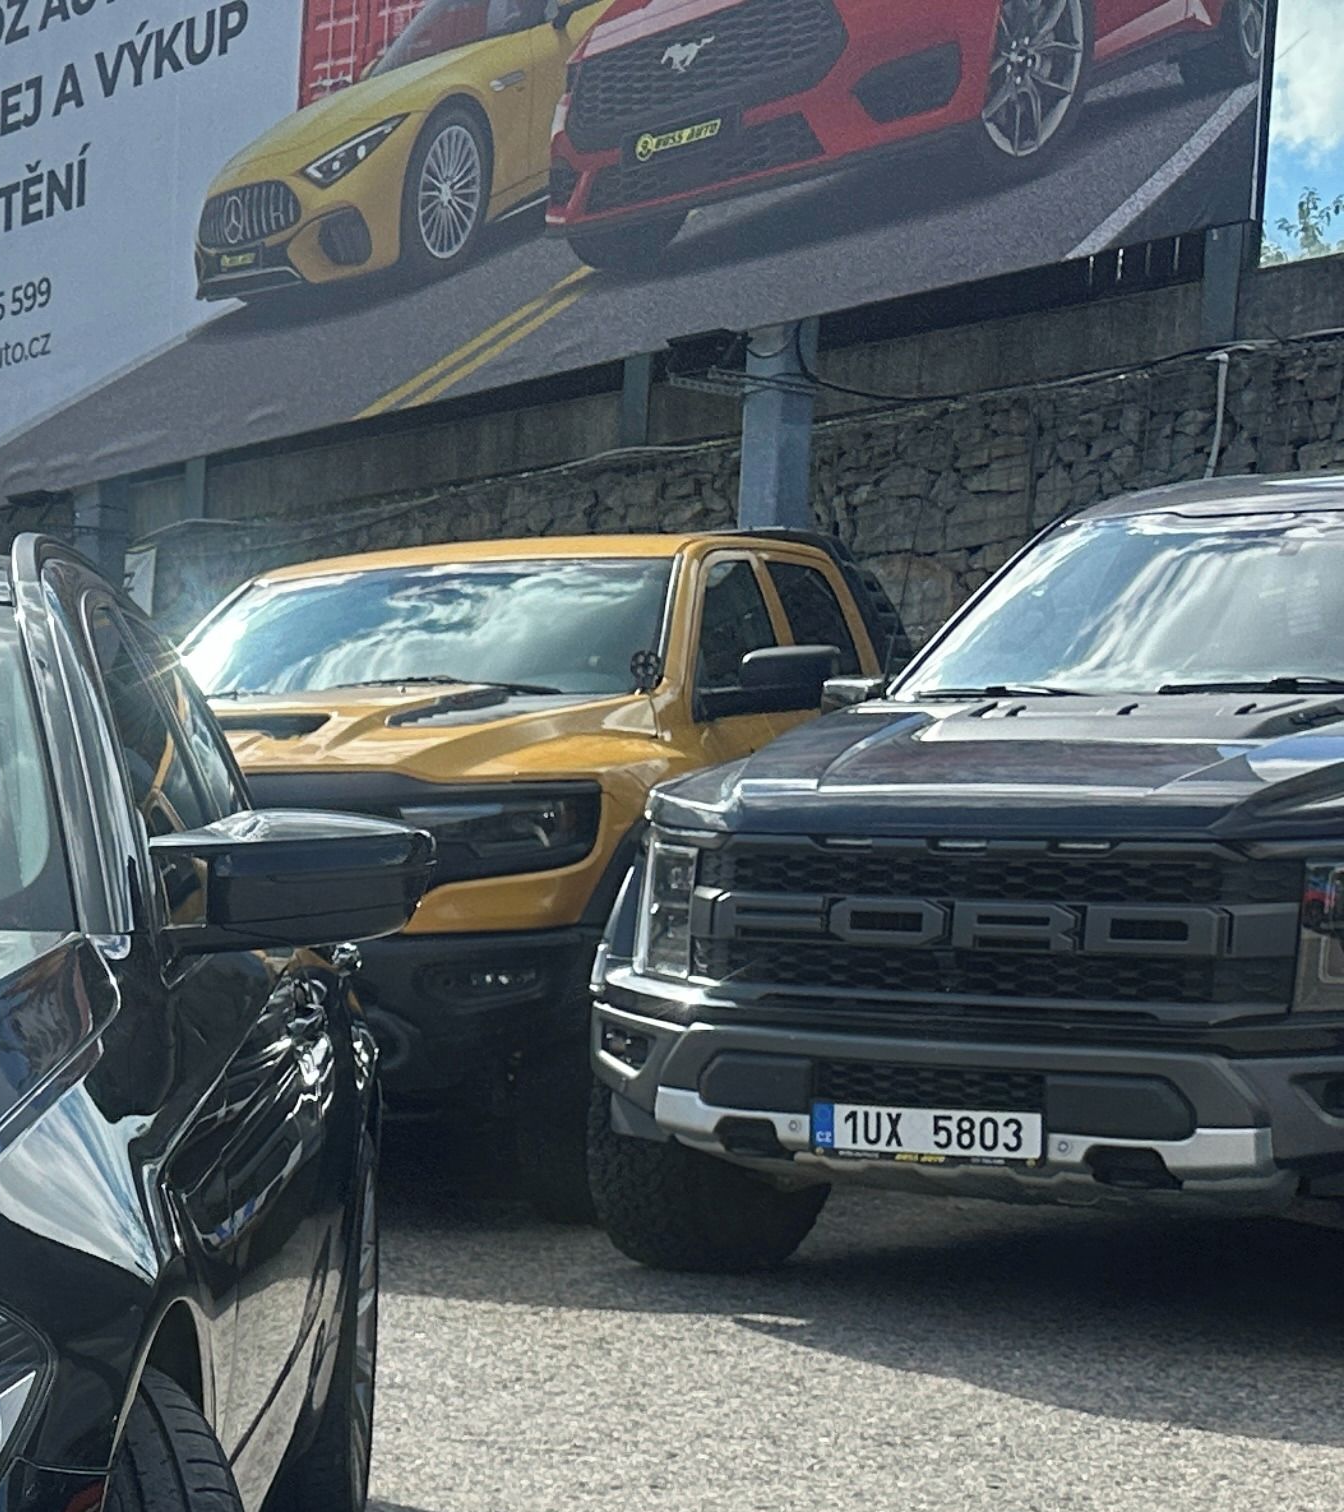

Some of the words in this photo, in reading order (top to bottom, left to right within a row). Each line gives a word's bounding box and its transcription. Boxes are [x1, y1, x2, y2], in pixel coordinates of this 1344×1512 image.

[52, 63, 84, 118] A
[95, 0, 249, 98] VÝKUP
[10, 276, 52, 316] 599
[714, 894, 1226, 958] FORD
[815, 1131, 832, 1143] CZ
[844, 1110, 903, 1147] 1UX
[933, 1115, 1023, 1152] 5803
